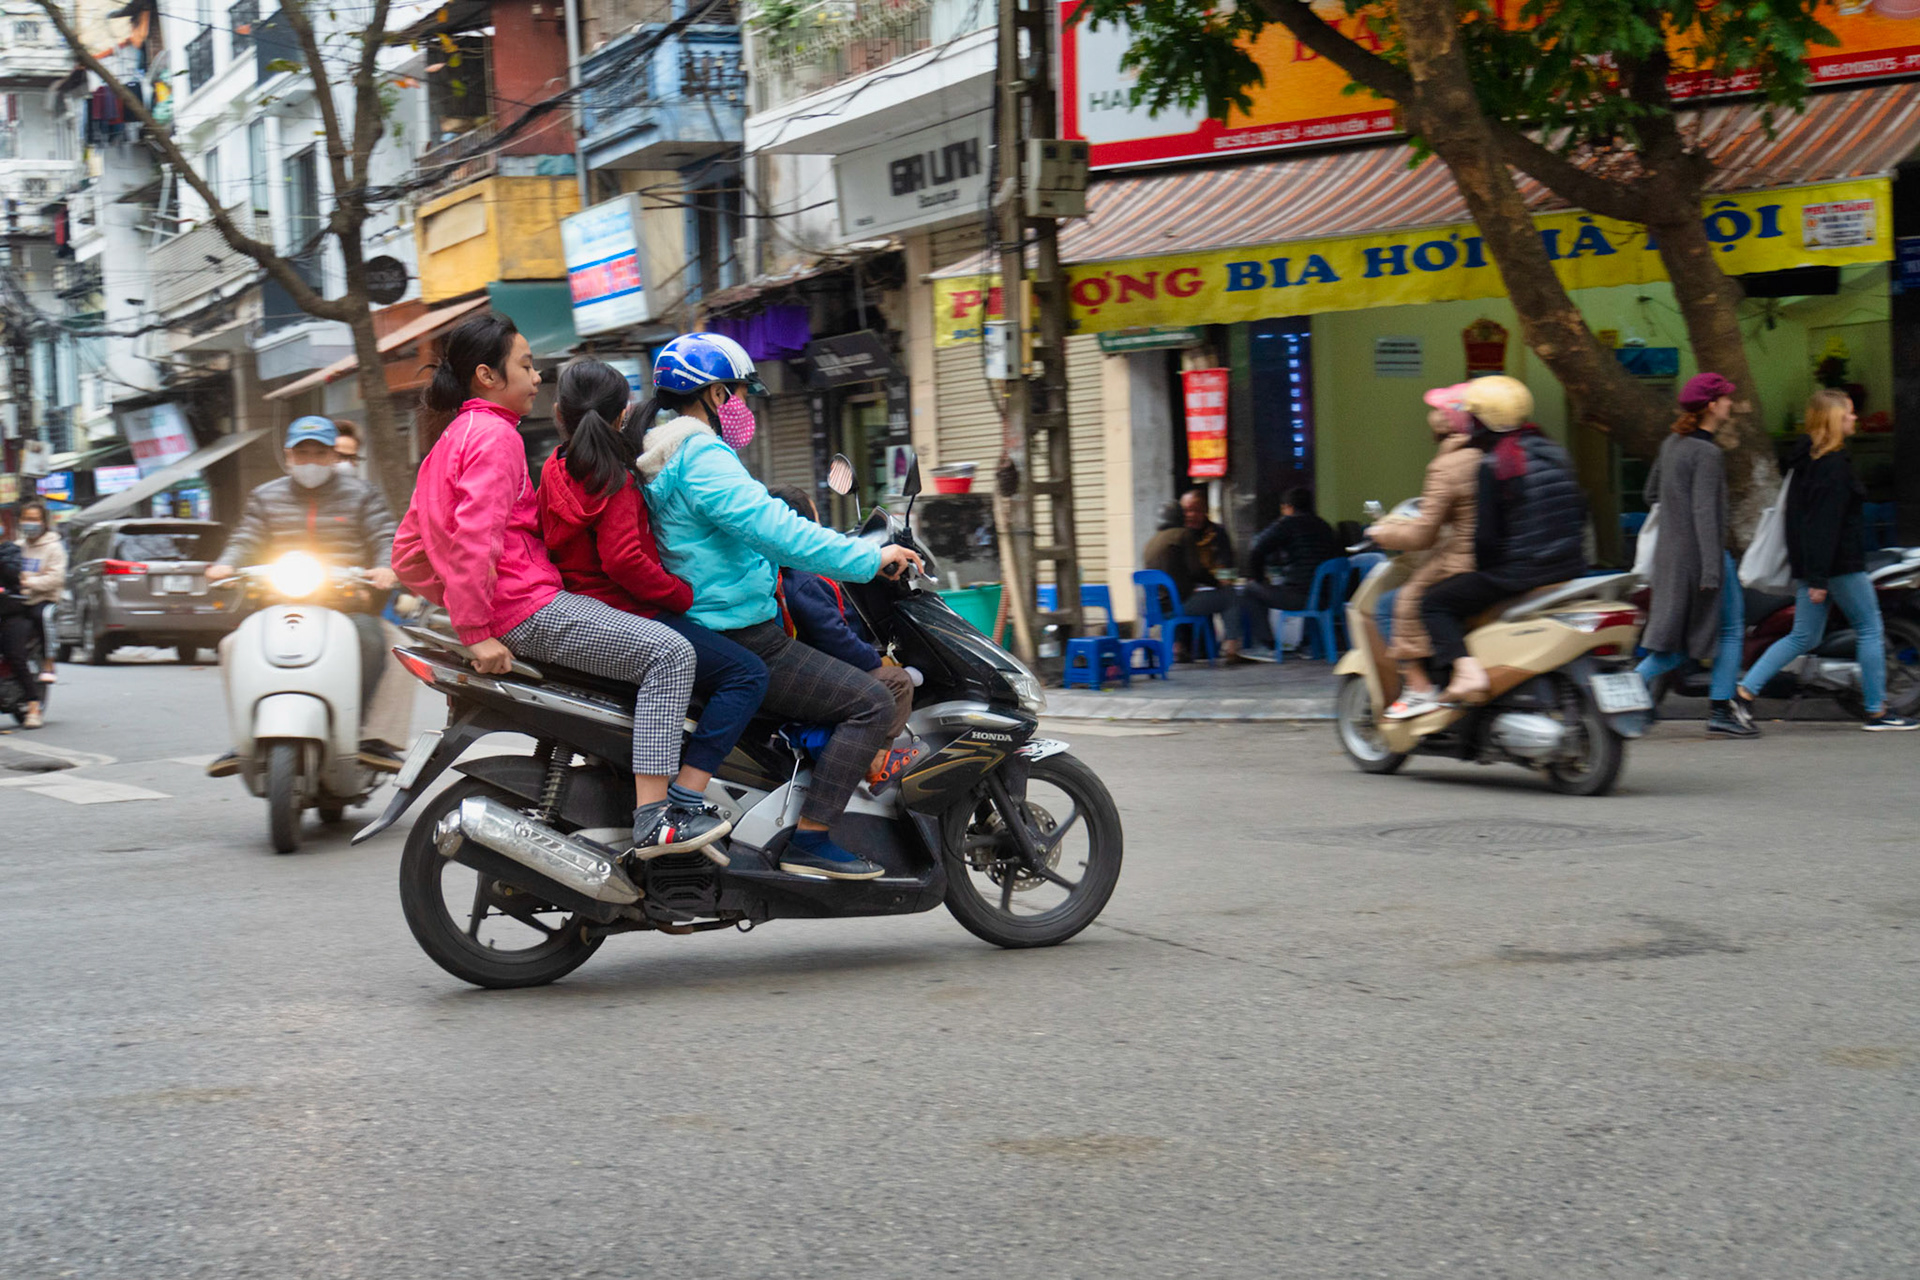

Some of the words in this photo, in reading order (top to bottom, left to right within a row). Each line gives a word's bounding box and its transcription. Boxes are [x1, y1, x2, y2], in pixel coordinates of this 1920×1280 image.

[1225, 254, 1341, 293] BIA
[1361, 232, 1488, 280] HƠI
[971, 731, 1013, 742] HONDA
